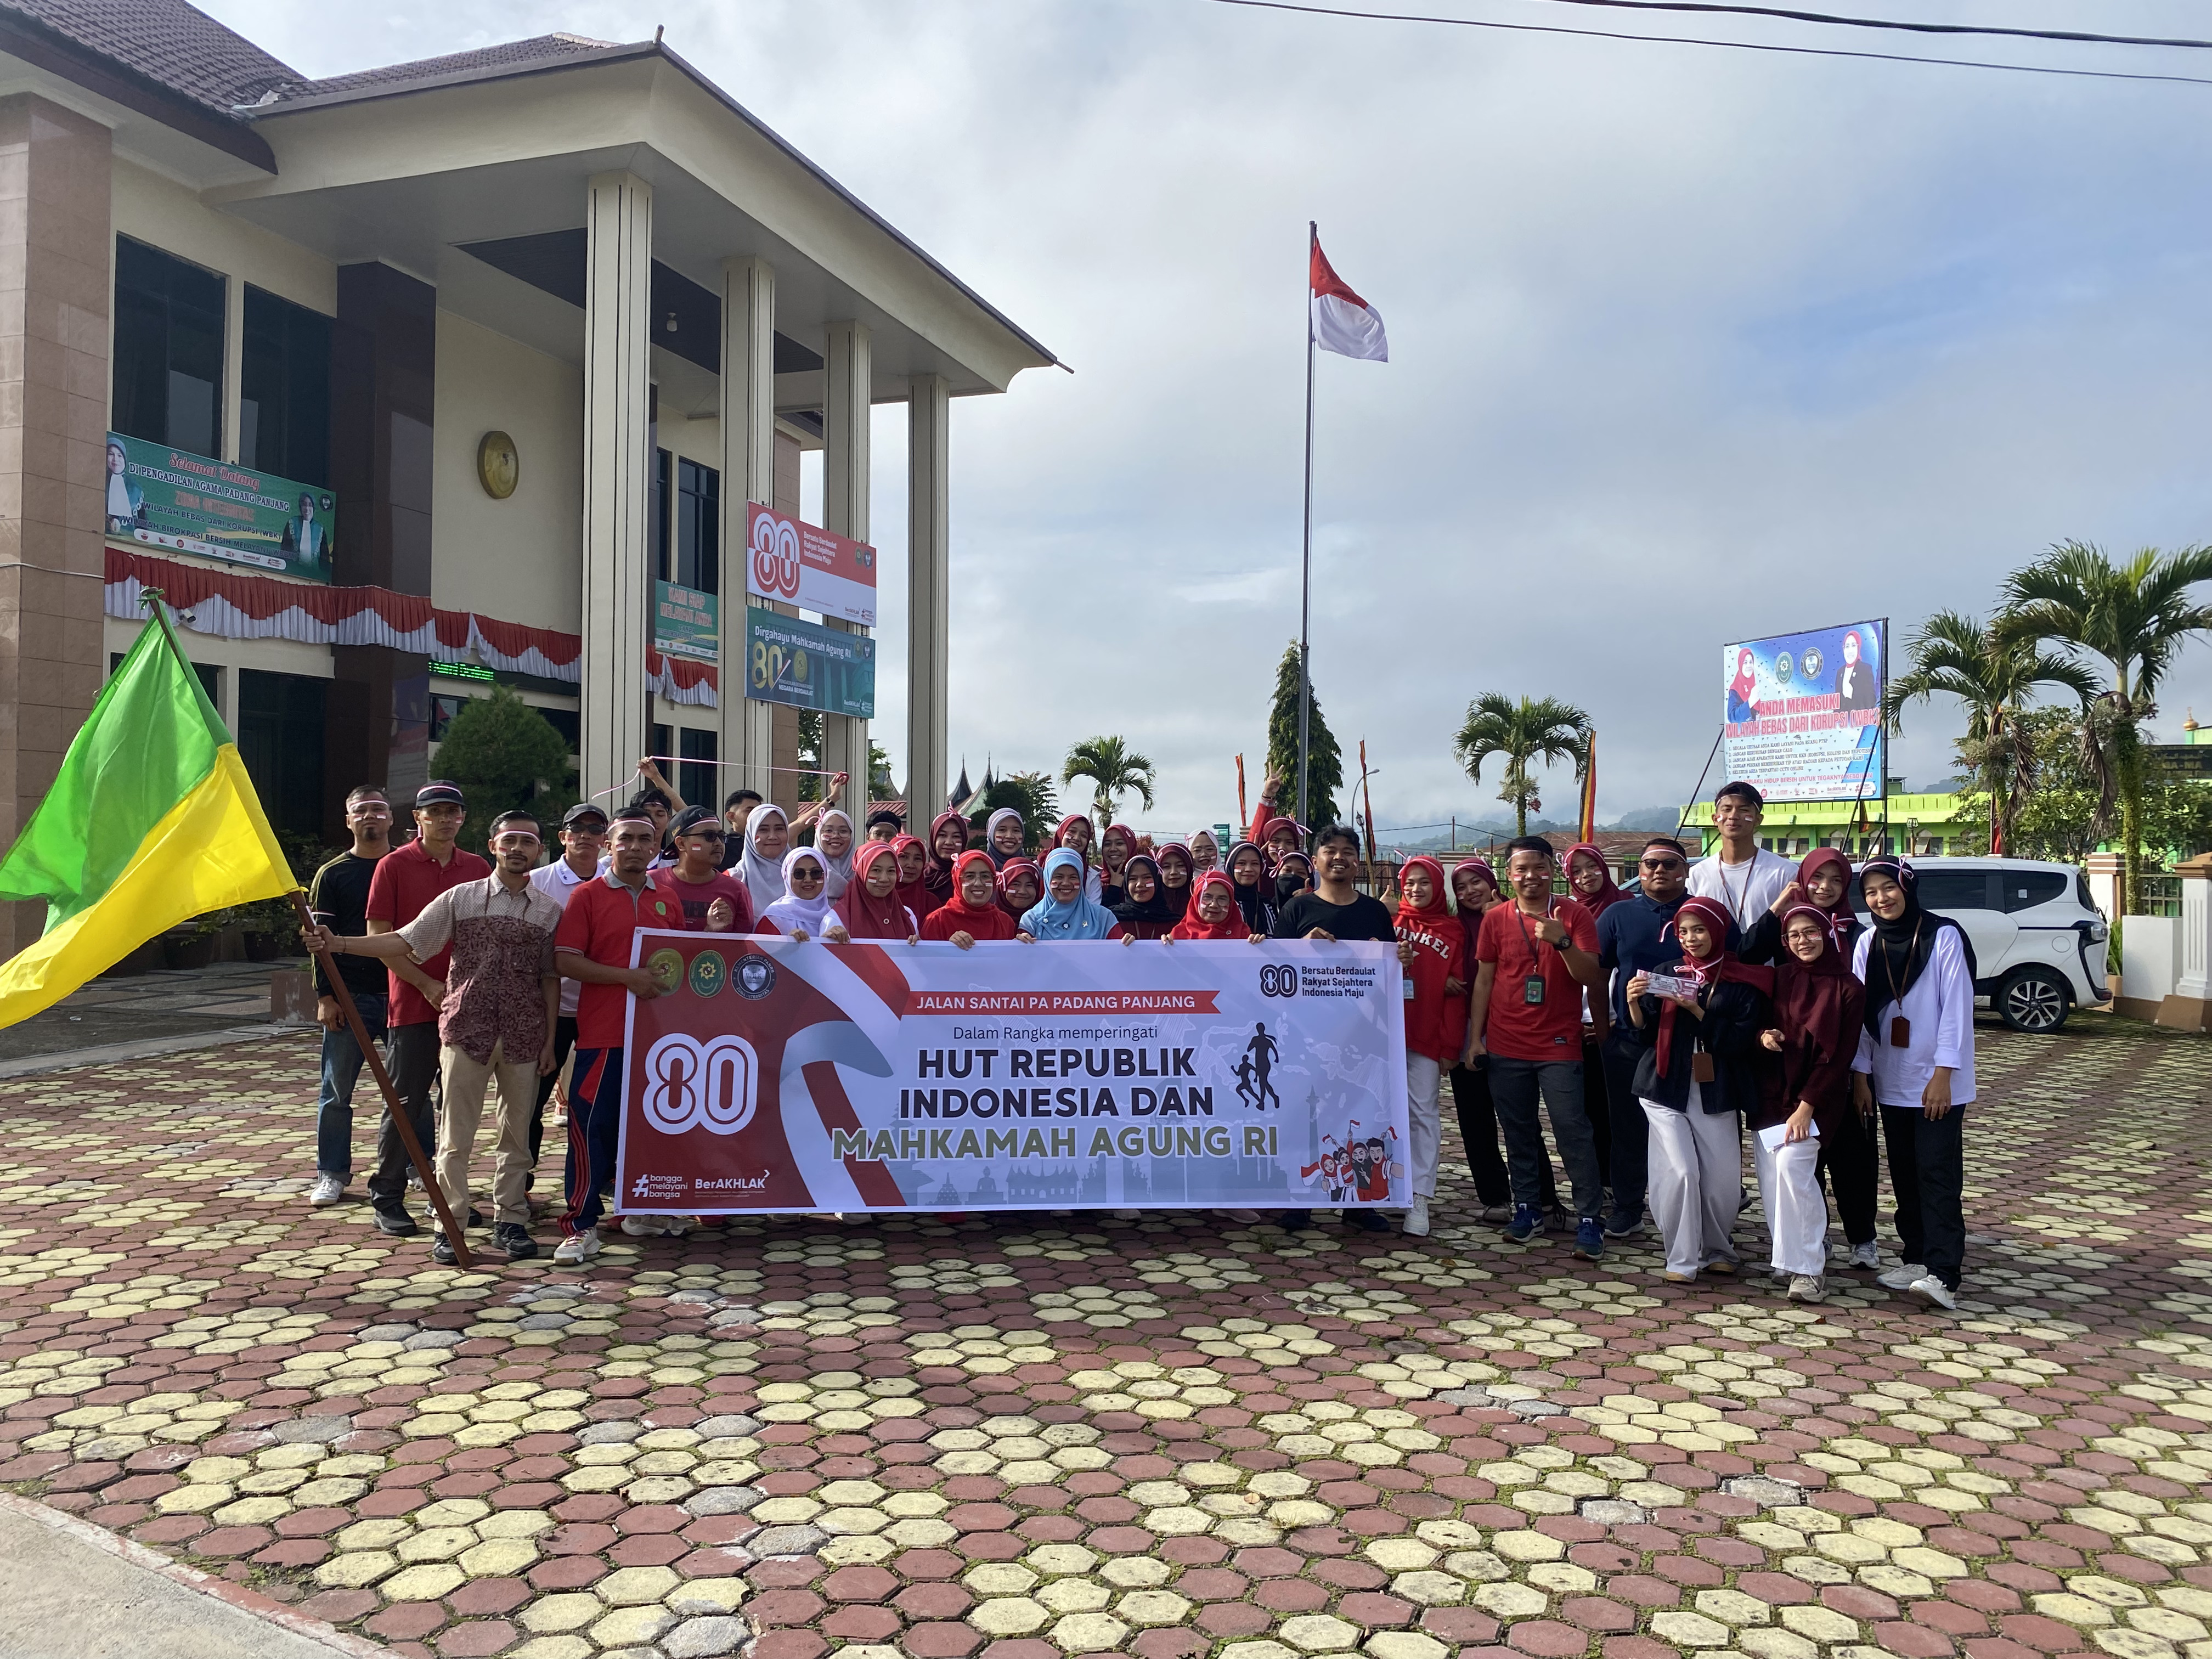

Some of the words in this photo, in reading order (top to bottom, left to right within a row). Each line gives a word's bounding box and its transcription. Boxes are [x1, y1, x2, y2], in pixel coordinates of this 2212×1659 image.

[169, 453, 217, 477] Selamat
[219, 466, 260, 492] Datang
[129, 462, 139, 474] DI
[140, 465, 193, 487] PENGADILAN
[195, 479, 223, 495] AGAMA
[224, 487, 255, 504] PADANG
[256, 495, 289, 512] PANJANG
[175, 490, 200, 509] ZONA
[143, 502, 179, 516] WILAYAH
[182, 511, 205, 522] BEBAS
[208, 517, 224, 527] DARI
[227, 522, 258, 534] KORUPSI
[260, 529, 281, 540] (WBK)
[122, 515, 159, 530] WILAYAH
[162, 524, 203, 539] BIROKRASI
[206, 535, 231, 545] BERSIH
[233, 540, 268, 554] MELAYANI
[804, 531, 819, 543] Bersatu
[819, 537, 837, 549] Berdaulat
[804, 540, 817, 551] Rakyat
[753, 512, 800, 599] 80
[804, 549, 822, 562] Indonesia
[823, 555, 832, 566] Maju
[668, 586, 687, 606] KAMI
[689, 592, 705, 610] SIAP
[661, 602, 693, 623] MELAYANI
[695, 611, 712, 628] ANDA
[755, 625, 790, 645] Dirgahayu
[791, 634, 825, 652] Mahkamah
[826, 644, 844, 659] Agung
[845, 649, 851, 658] RI
[778, 684, 794, 692] NEGARA
[794, 687, 813, 696] BERDAULAT
[1760, 699, 1785, 718] ANDA
[1786, 692, 1840, 715] MEMASUKI
[1725, 721, 1759, 739] WILAYAH
[1761, 718, 1787, 735] BEBAS
[1789, 715, 1809, 733] DARI
[1811, 710, 1848, 731] KORUPSI
[1850, 707, 1880, 729] (WBK)
[734, 955, 764, 972] KEMENTERIAN
[764, 958, 775, 973] PANRB
[1302, 966, 1334, 975] Bersatu
[1336, 967, 1376, 975] Berdaulat
[1260, 964, 1297, 998] 80
[1302, 977, 1330, 988] Rakyat
[1333, 978, 1373, 988] Sejahtera
[736, 987, 746, 997] ZONA
[746, 989, 770, 999] INTEGRITAS
[917, 997, 964, 1009] JALAN
[969, 997, 1024, 1009] SANTAI
[1029, 997, 1048, 1009] PA
[1053, 996, 1118, 1009] PADANG
[1122, 996, 1195, 1008] PANJANG
[1302, 988, 1343, 996] Indonesia
[1345, 989, 1364, 998] Maju
[953, 1026, 998, 1039] Dalam
[1004, 1026, 1054, 1042] Rangka
[1059, 1025, 1158, 1041] memperingati
[918, 1049, 998, 1079] HUT
[1011, 1048, 1197, 1077] REPUBLIK
[643, 1033, 759, 1135] 80
[900, 1087, 1119, 1118] INDONESIA
[1131, 1087, 1213, 1116] DAN
[833, 1127, 1076, 1160] MAHKAMAH
[1087, 1126, 1231, 1157] AGUNG
[1243, 1126, 1278, 1156] RI
[650, 1175, 682, 1183] bangga
[650, 1183, 688, 1192] melayani
[695, 1178, 765, 1189] BerAKHLAK
[649, 1191, 680, 1200] bangsa
